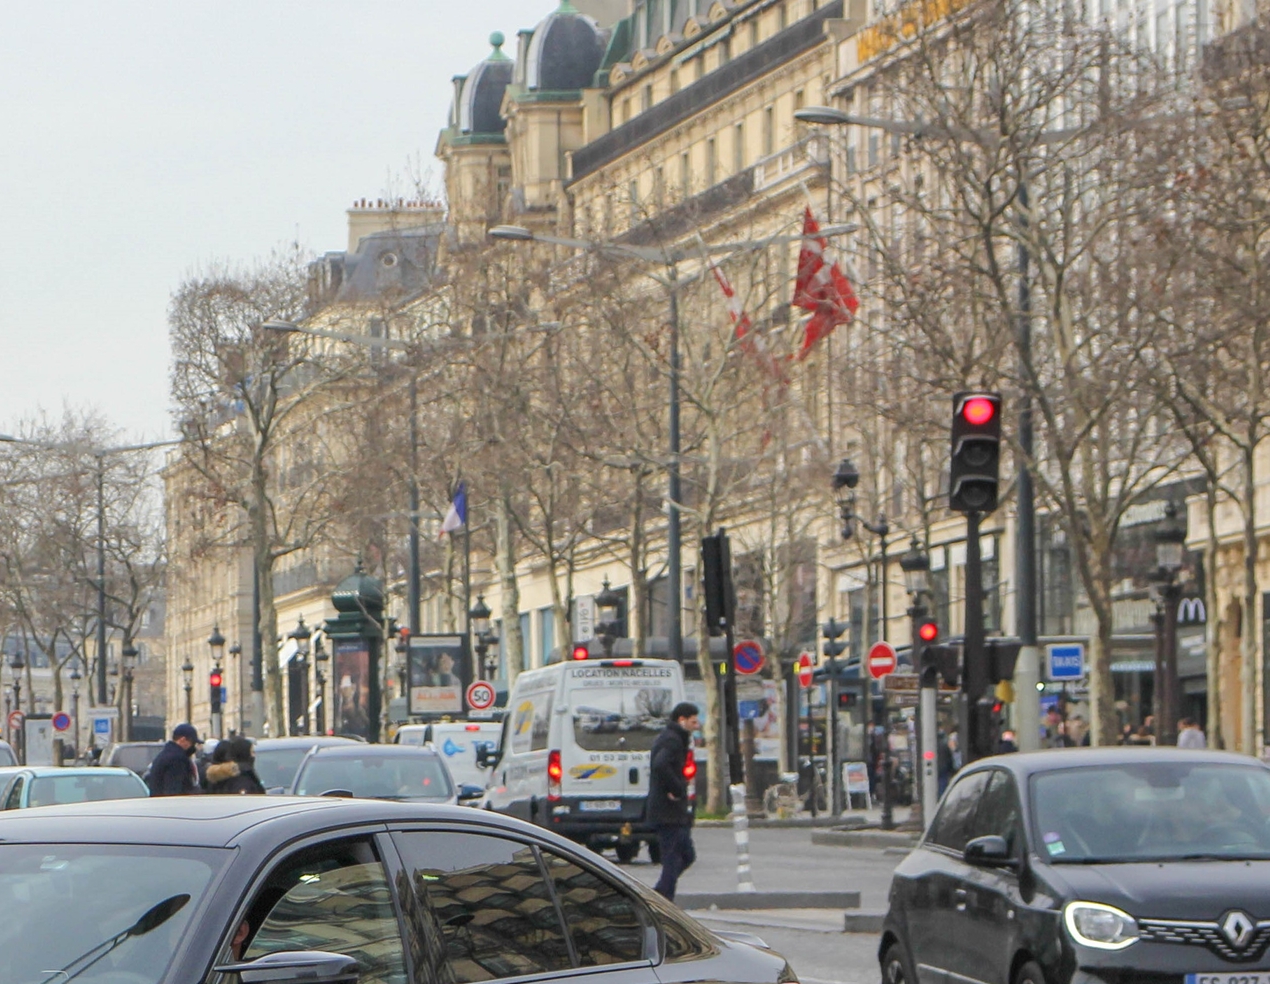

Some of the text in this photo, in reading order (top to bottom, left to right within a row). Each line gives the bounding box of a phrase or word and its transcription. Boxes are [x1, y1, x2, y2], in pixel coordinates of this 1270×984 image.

[571, 668, 672, 678] LOCATION NACELLES
[474, 690, 490, 701] 50
